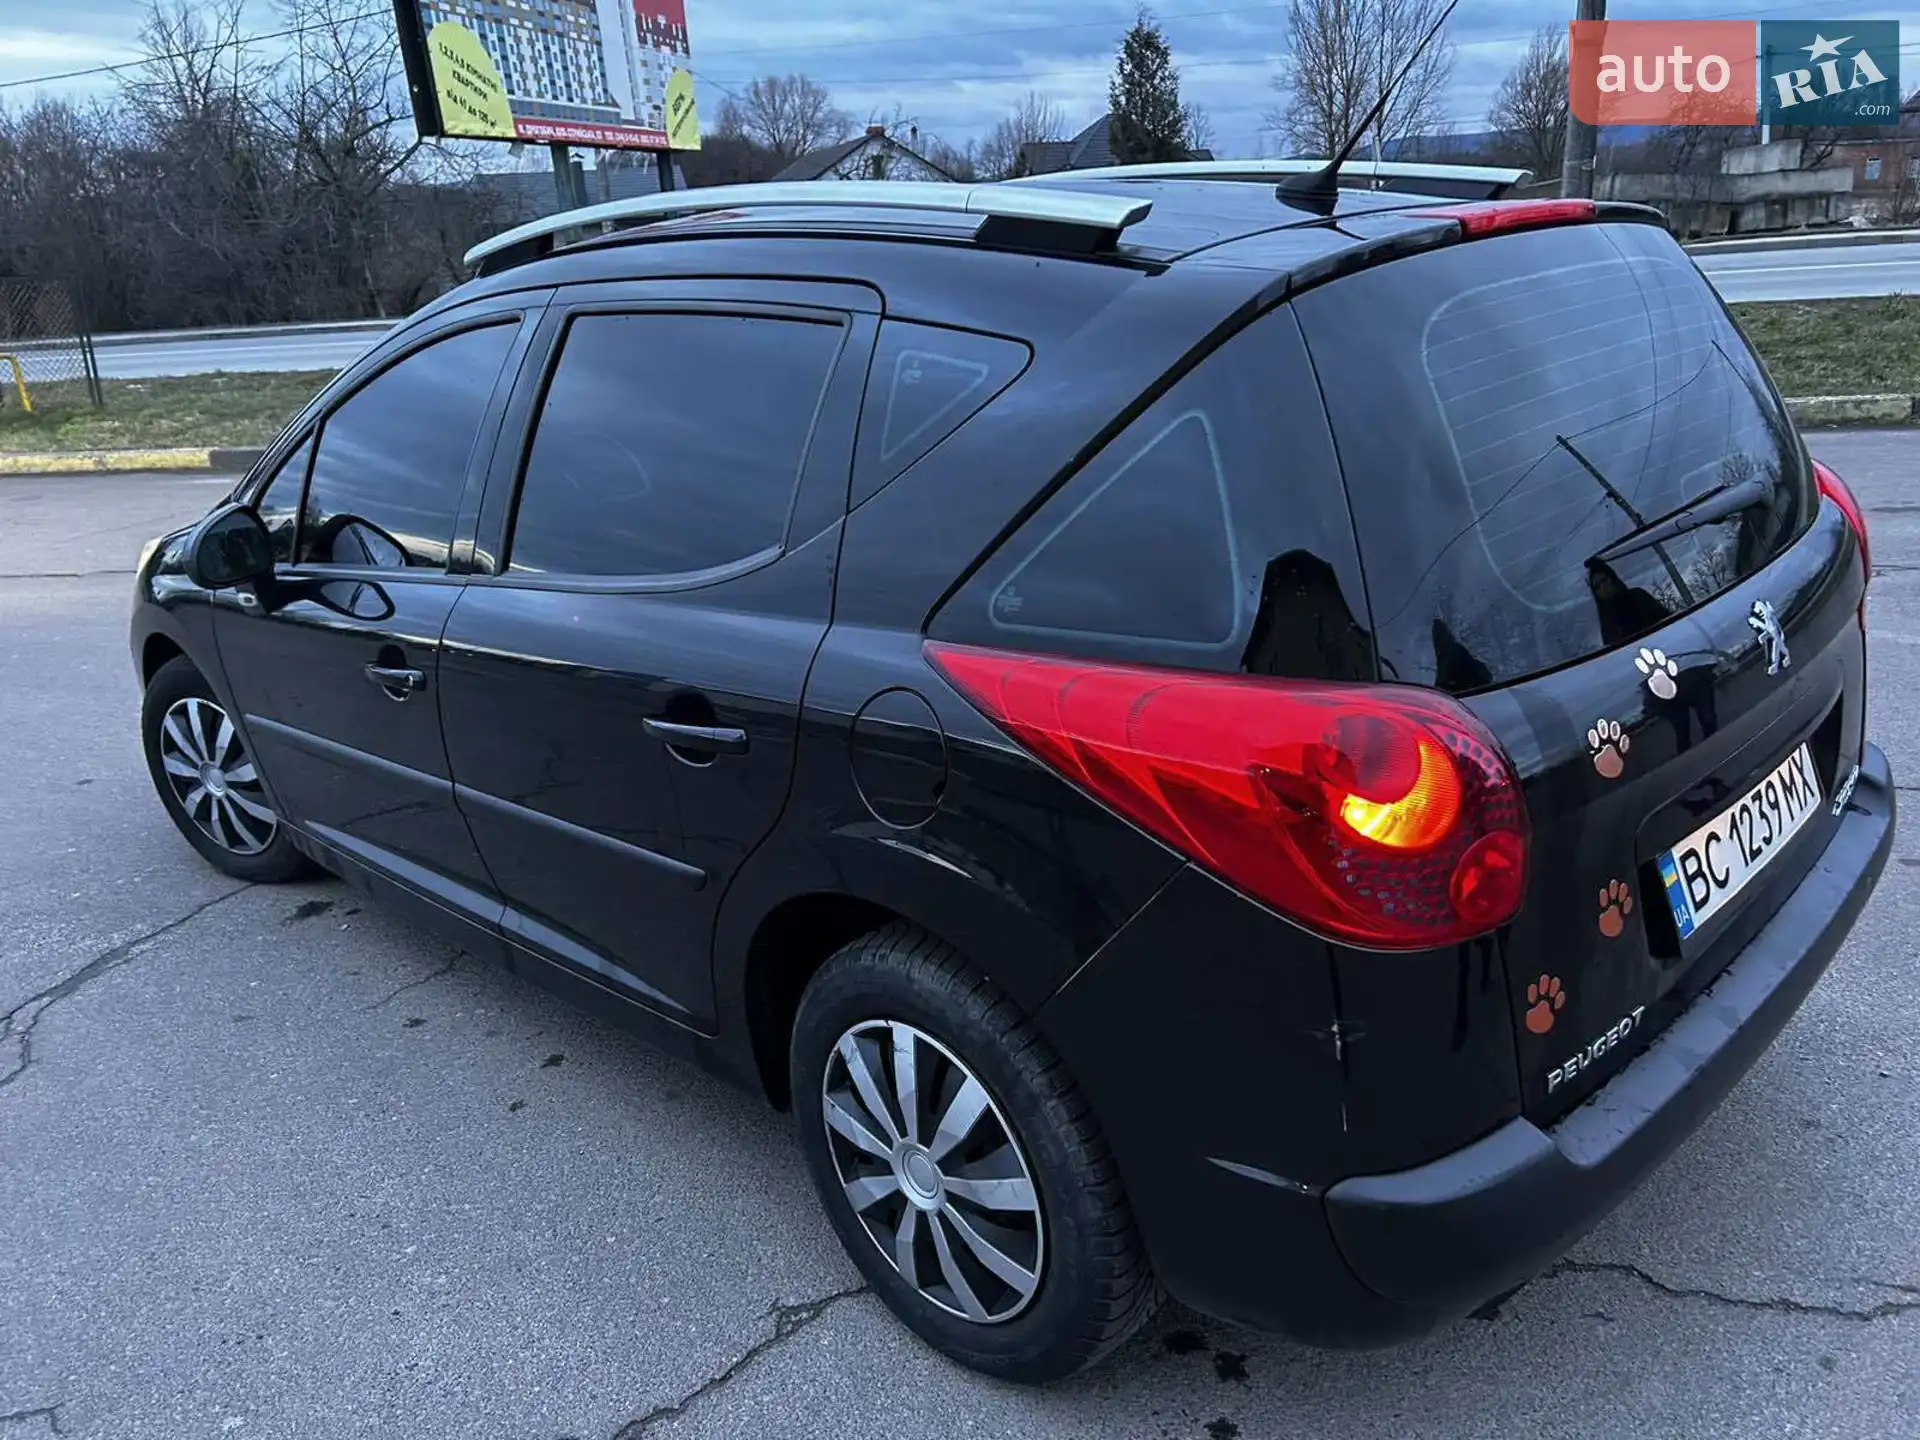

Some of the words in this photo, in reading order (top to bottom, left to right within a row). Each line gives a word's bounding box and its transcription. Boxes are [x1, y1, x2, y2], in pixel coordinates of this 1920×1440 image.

[1678, 831, 1730, 913] BC
[1729, 780, 1783, 868] 1239
[1777, 747, 1815, 824] MX
[1673, 903, 1690, 928] UA
[1547, 1005, 1646, 1094] PEUGEOT
